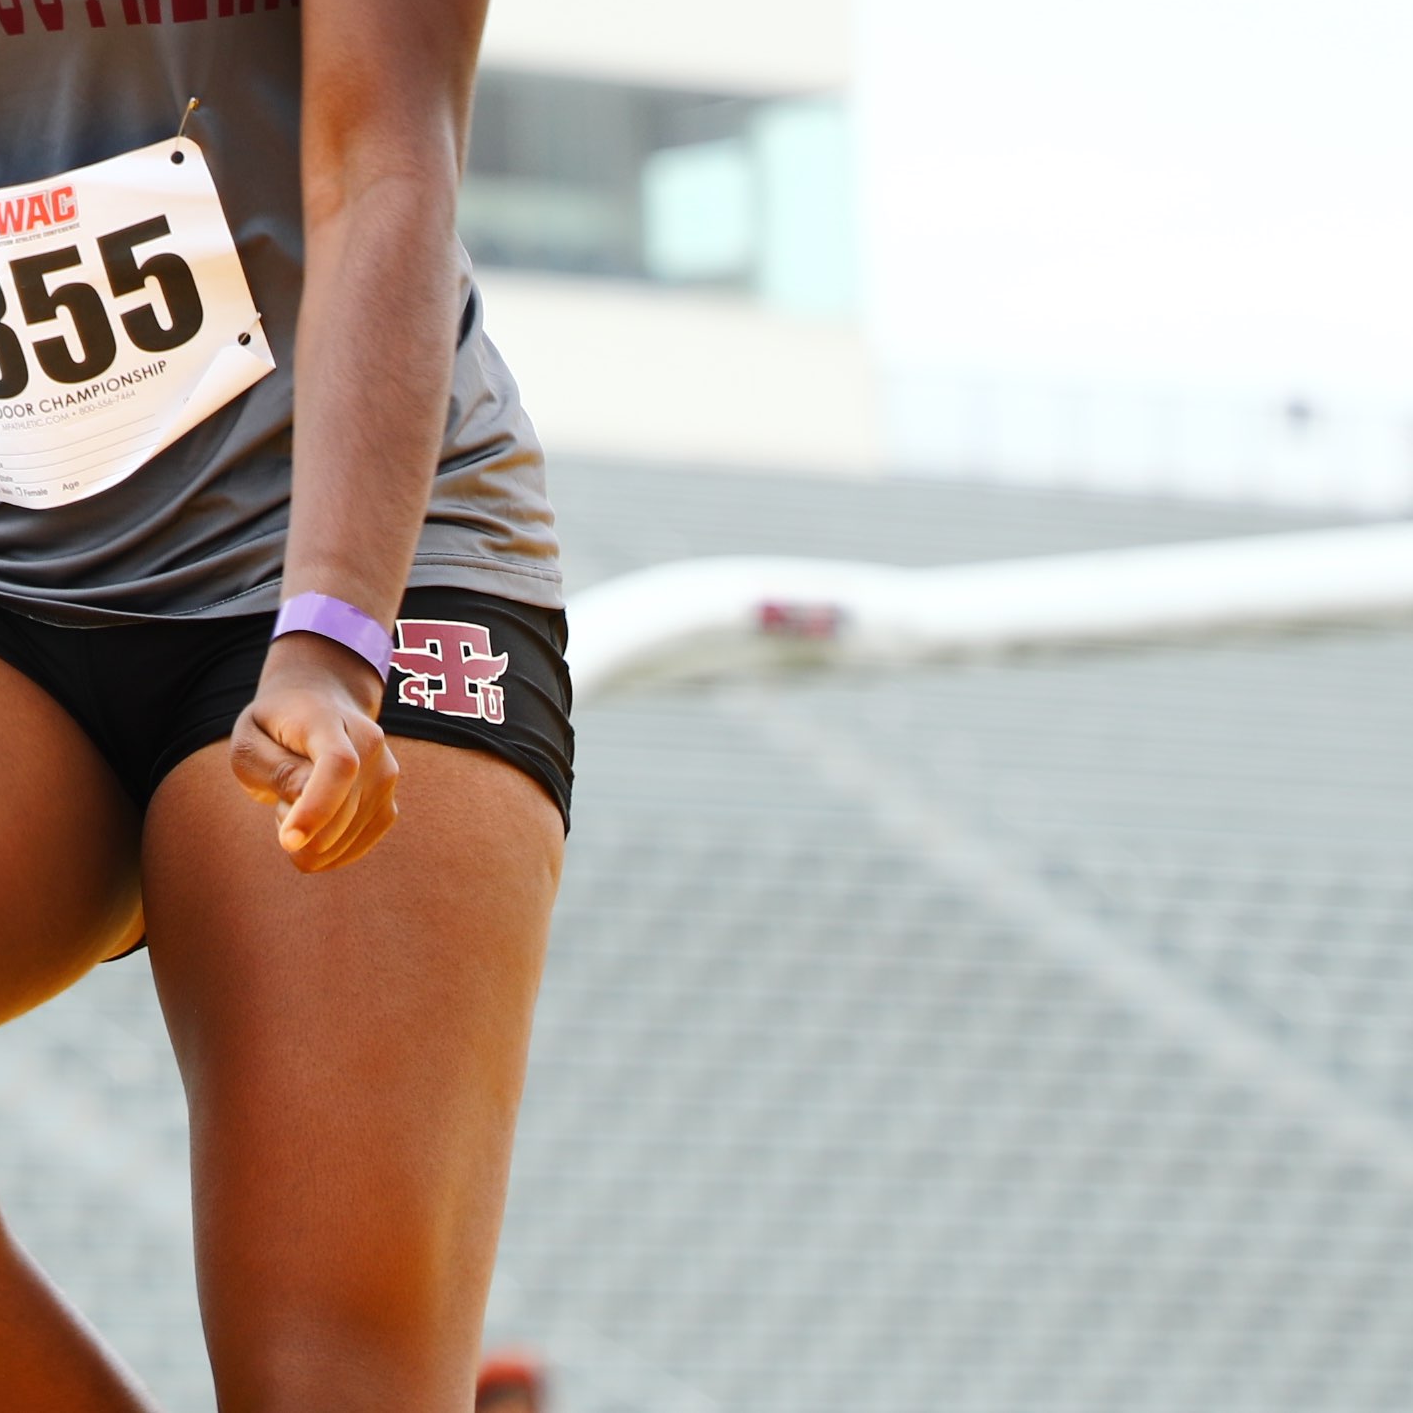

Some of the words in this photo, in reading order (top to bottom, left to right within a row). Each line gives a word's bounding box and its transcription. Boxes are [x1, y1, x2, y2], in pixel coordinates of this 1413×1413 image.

[38, 360, 168, 414] CHAMPIONSHIP
[23, 488, 49, 497] Female
[62, 480, 81, 491] Age
